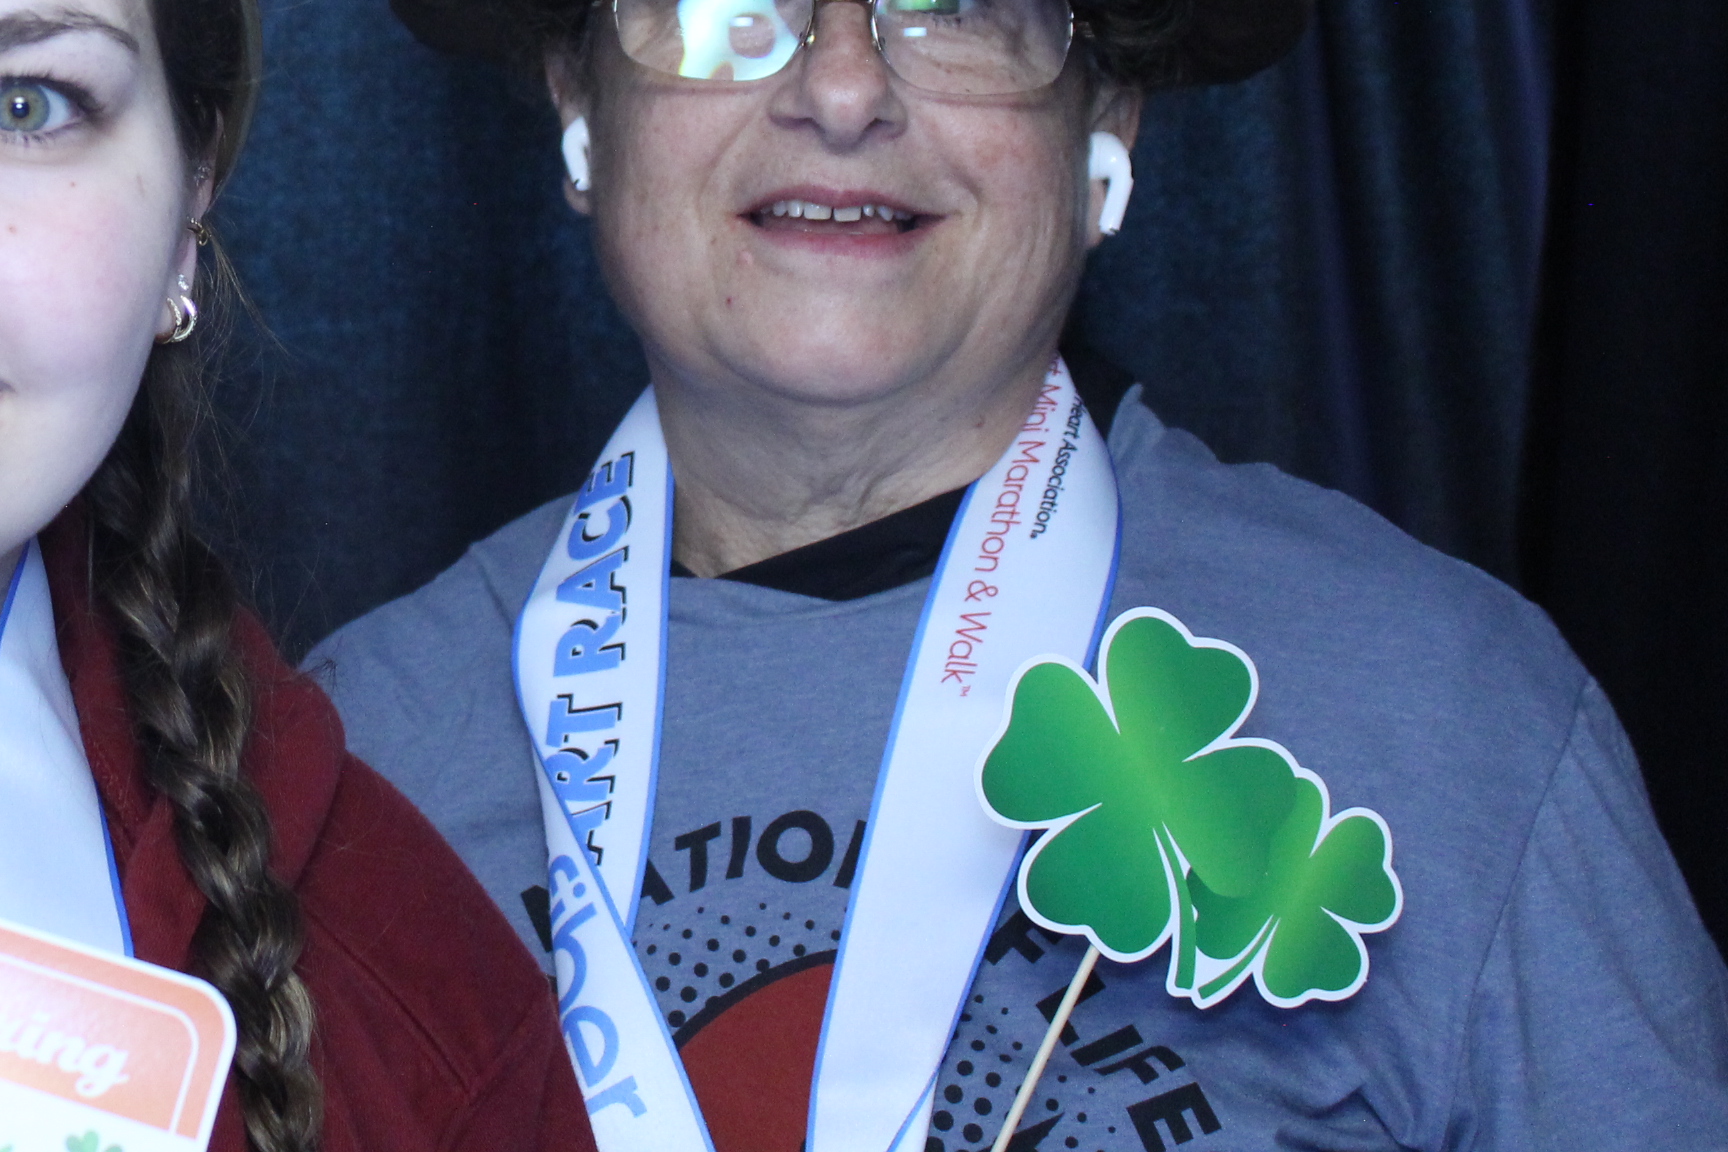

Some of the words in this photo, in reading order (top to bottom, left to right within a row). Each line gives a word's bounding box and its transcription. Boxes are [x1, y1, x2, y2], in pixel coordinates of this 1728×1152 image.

[1022, 383, 1062, 433] Mini
[974, 439, 1047, 572] Marathon
[553, 451, 636, 678] RACE
[964, 579, 999, 602] &
